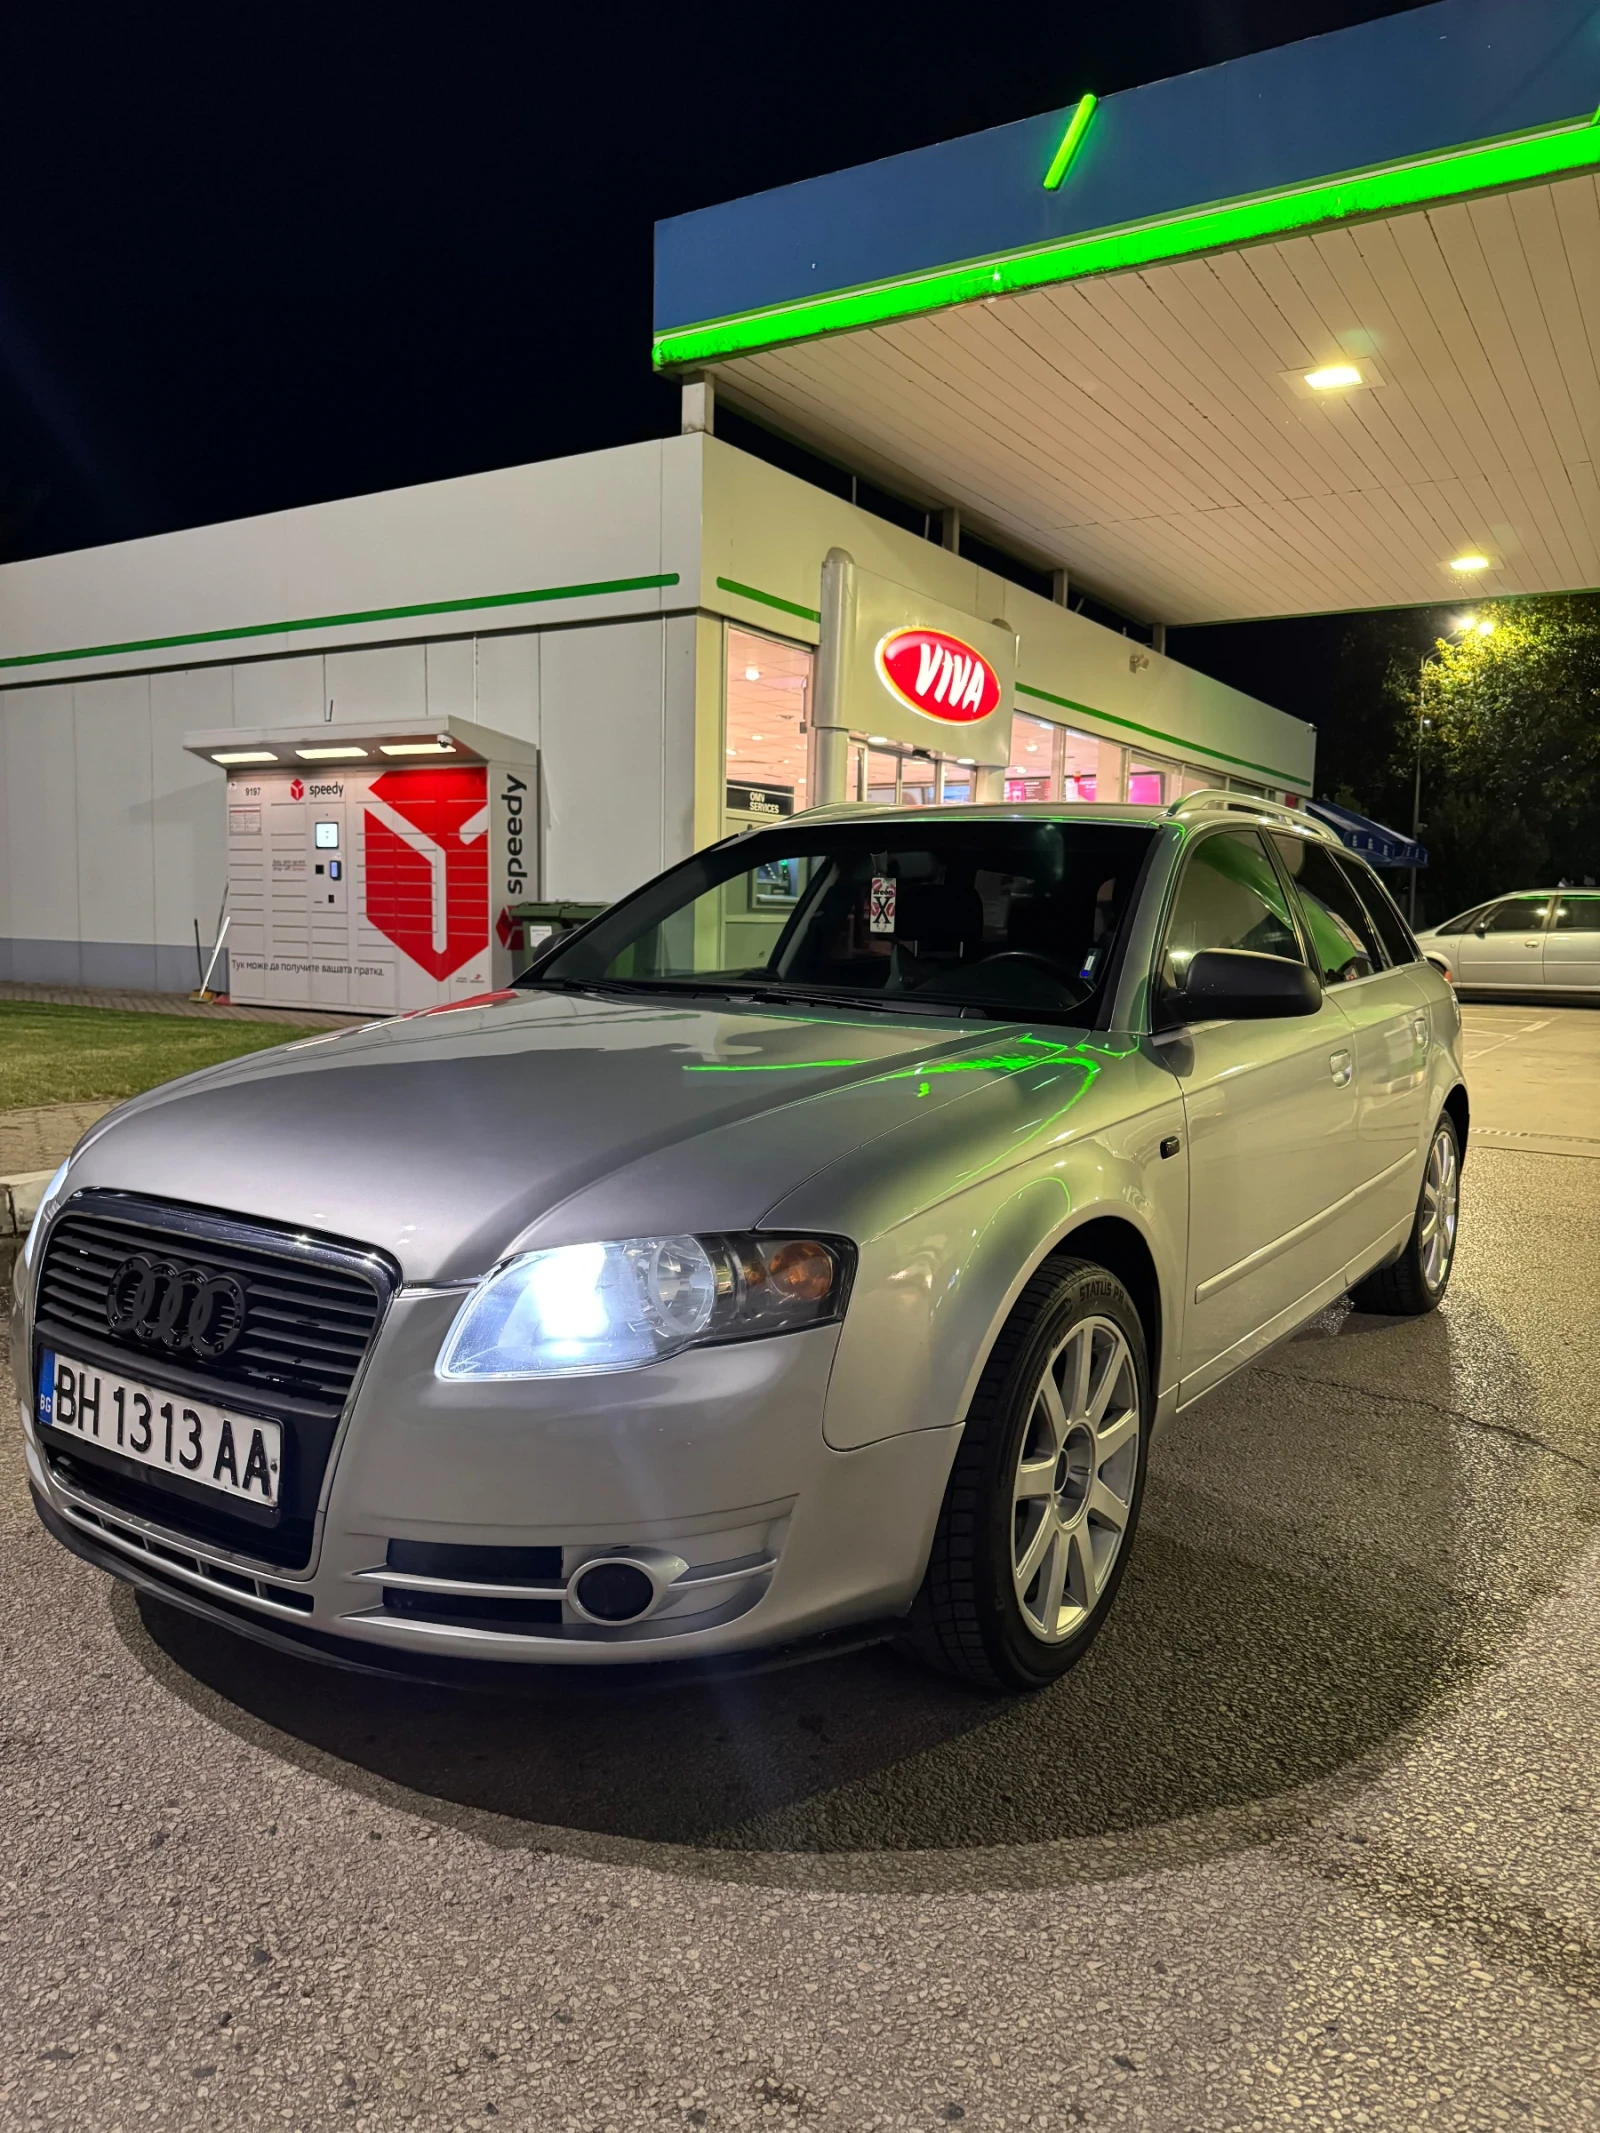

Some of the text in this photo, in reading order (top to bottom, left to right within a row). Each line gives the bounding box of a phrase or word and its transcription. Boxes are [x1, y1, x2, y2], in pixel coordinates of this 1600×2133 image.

[915, 643, 985, 712] VIVA
[245, 787, 261, 796] 9197
[309, 781, 344, 798] speedy
[749, 792, 765, 802] OMV
[749, 802, 779, 813] SERVICES
[501, 772, 527, 894] speedy
[872, 896, 893, 924] X
[231, 959, 385, 977] Тук може да получите вашата пратка.
[1079, 1281, 1111, 1301] STATUS
[40, 1393, 51, 1414] BG
[56, 1365, 271, 1498] BH 1313 AA
